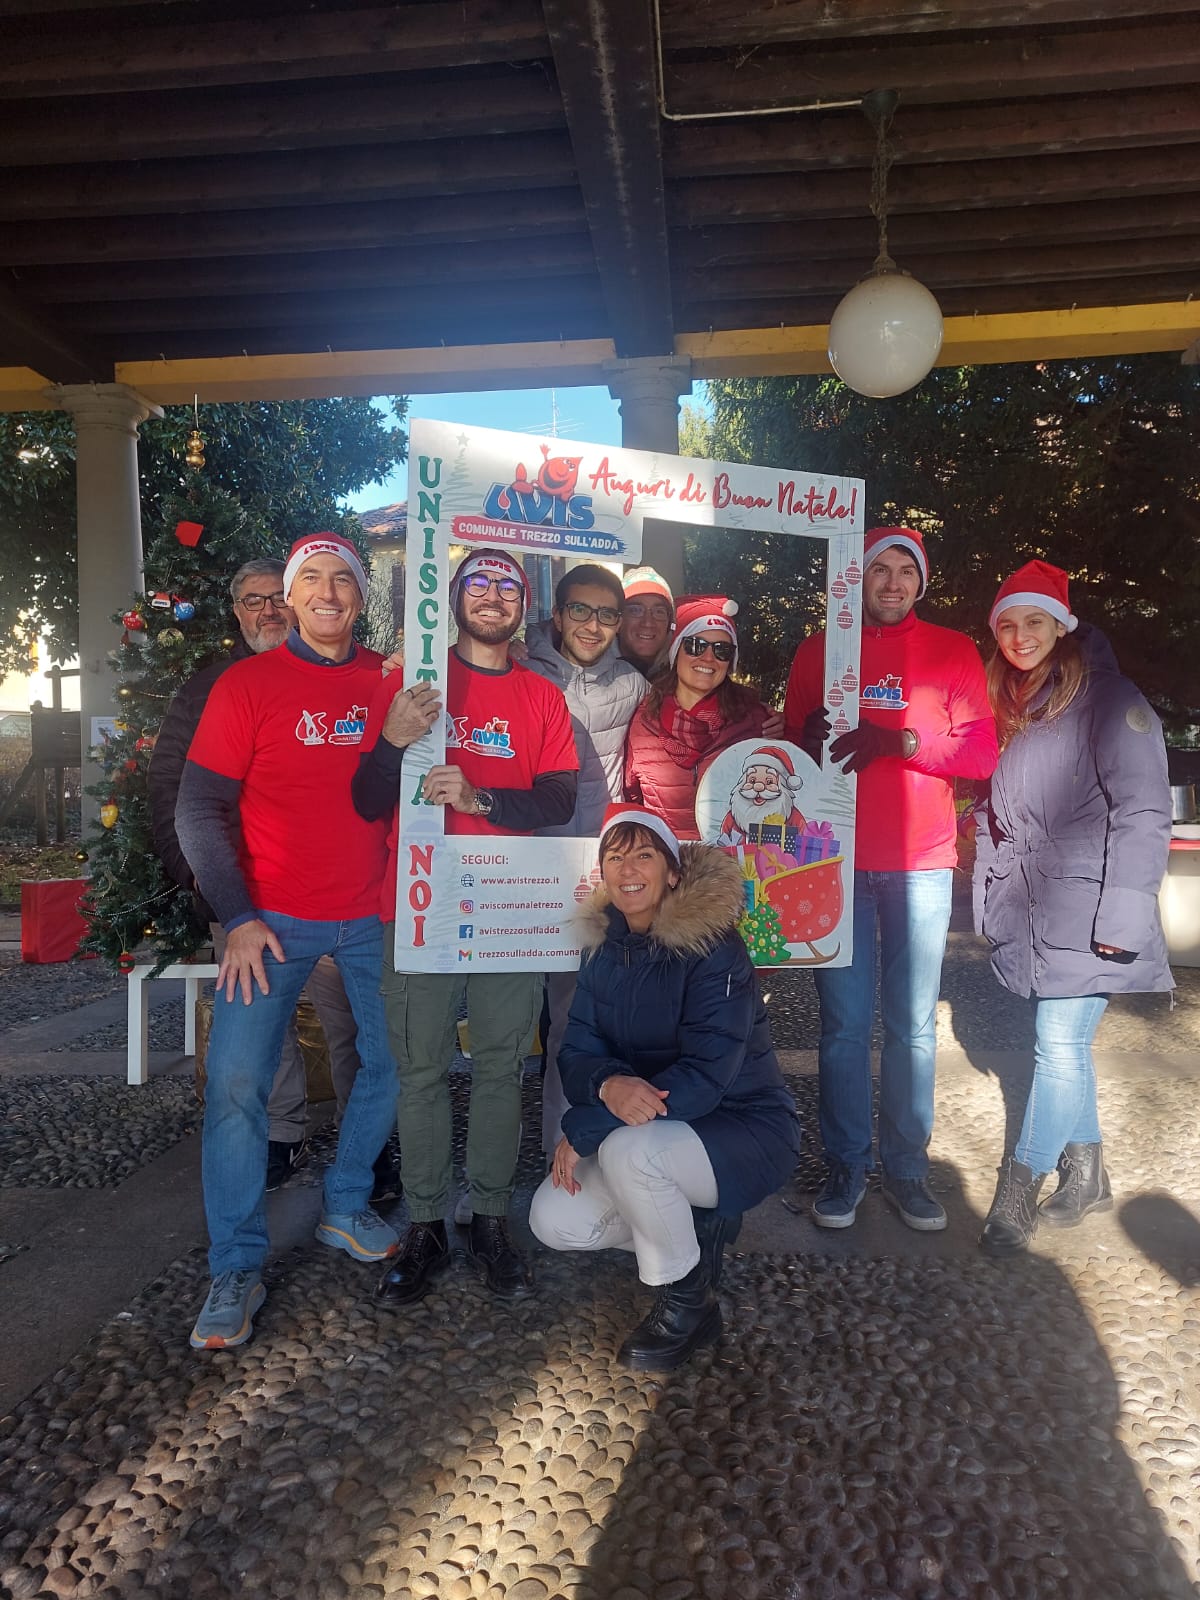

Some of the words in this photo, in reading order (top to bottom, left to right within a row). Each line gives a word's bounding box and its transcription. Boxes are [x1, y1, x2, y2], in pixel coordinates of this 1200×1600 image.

[588, 456, 676, 516] Auguri
[679, 472, 706, 503] di
[778, 480, 858, 525] Natale!
[483, 482, 594, 530] AVIS
[458, 522, 516, 540] COMUNALE
[520, 529, 561, 544] TREZZO
[564, 535, 619, 551] SULL'ADDA
[417, 455, 442, 735] UNISCIT
[864, 686, 901, 700] AVIS
[335, 720, 365, 734] AVI
[472, 729, 509, 747] AVIS
[461, 855, 509, 865] SEGUICI:
[480, 877, 560, 885] www.avistrezzo.it
[409, 845, 434, 946] NOI
[479, 901, 564, 910] aviscomunaletrezzo
[479, 926, 560, 935] avistrezzosulladda
